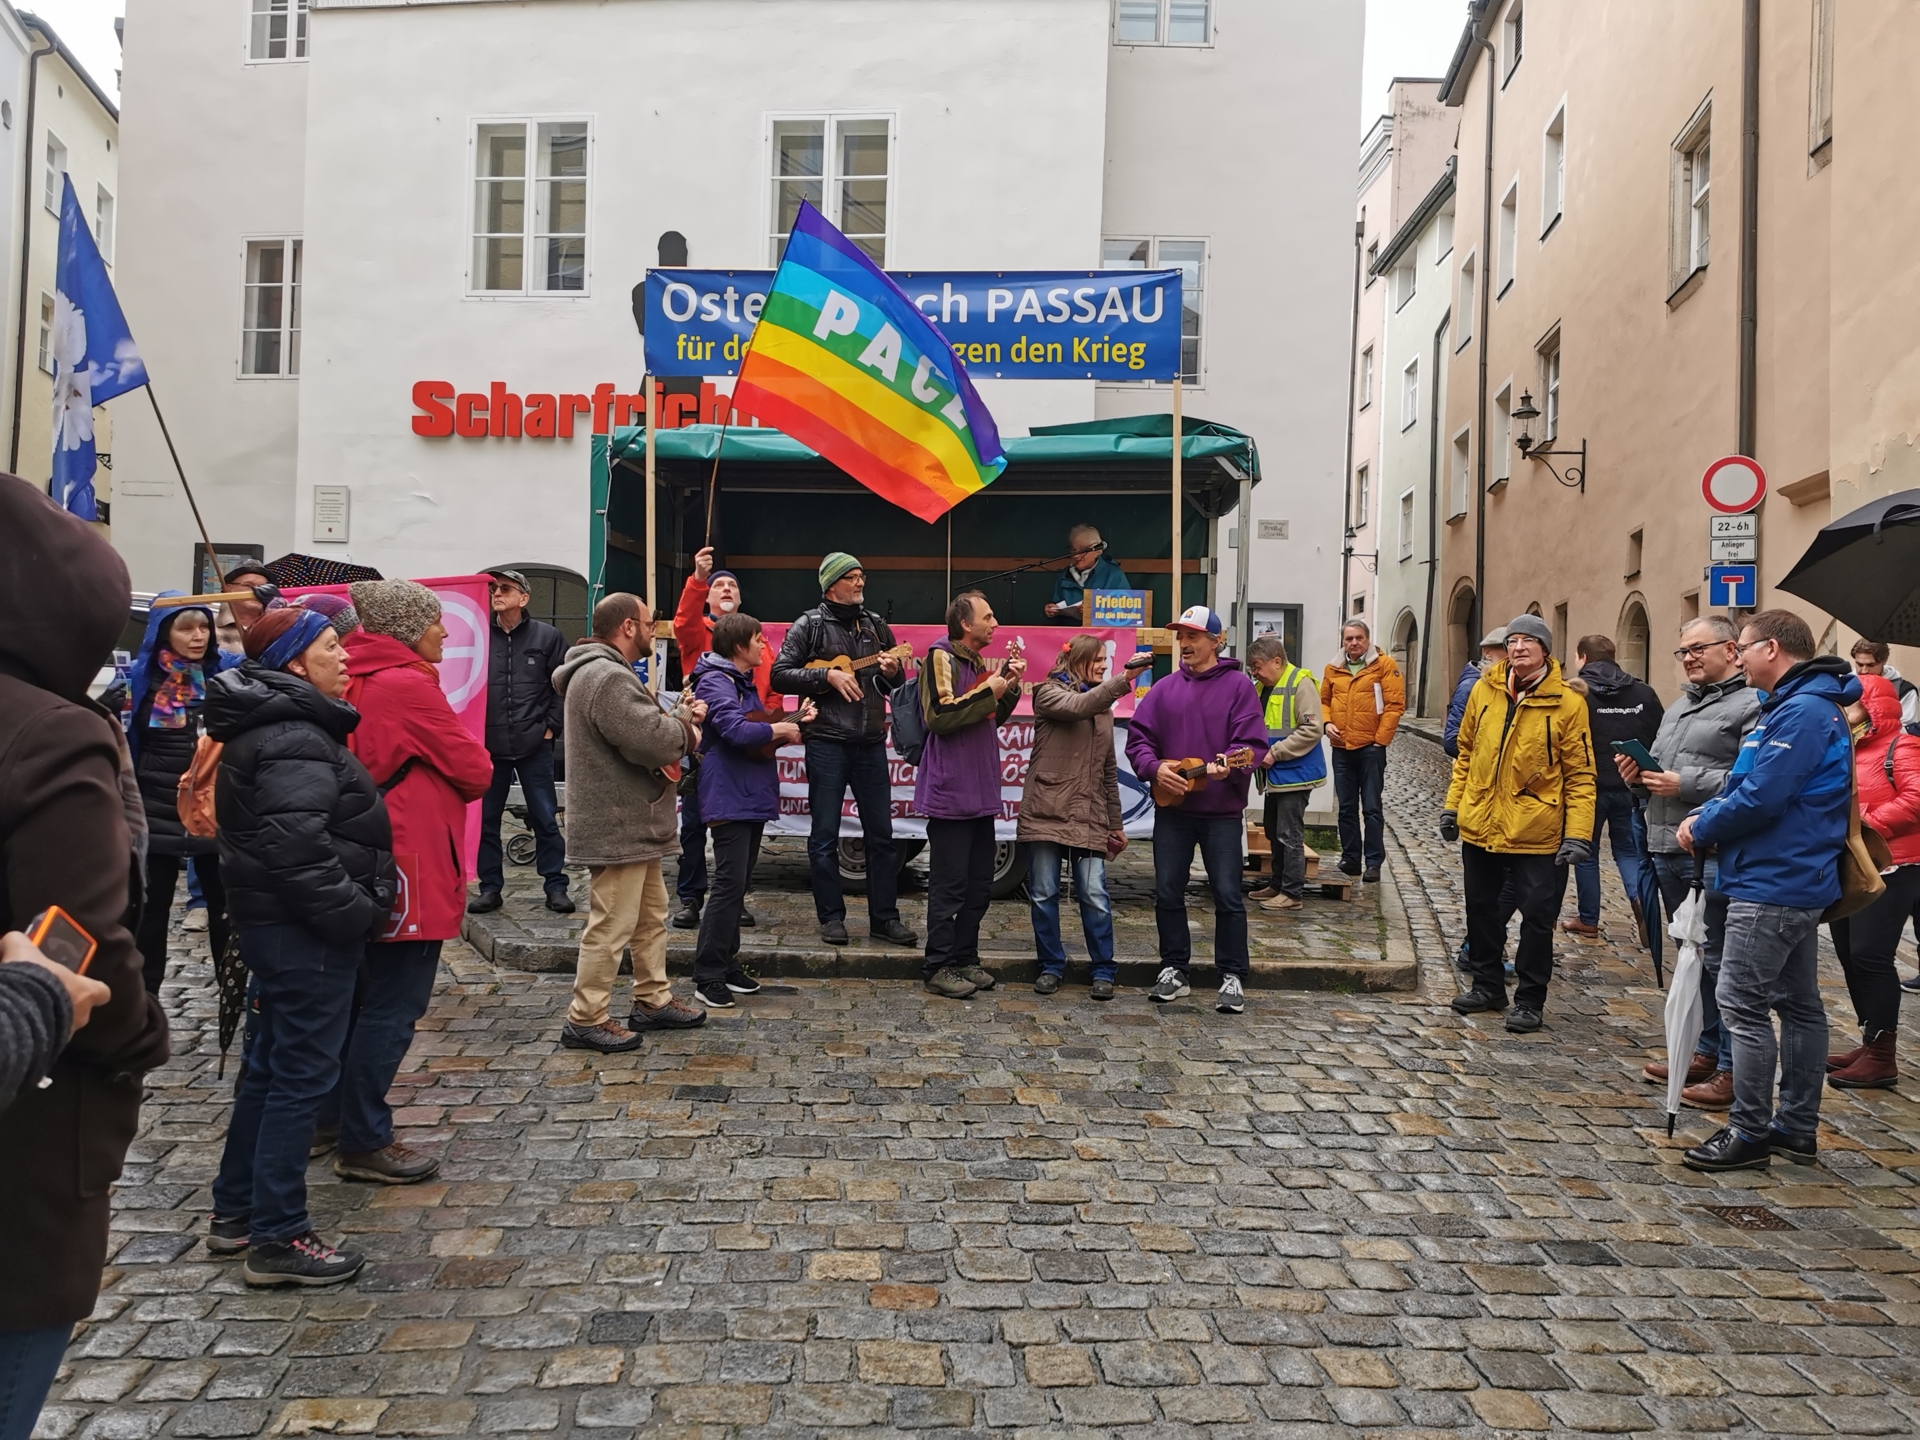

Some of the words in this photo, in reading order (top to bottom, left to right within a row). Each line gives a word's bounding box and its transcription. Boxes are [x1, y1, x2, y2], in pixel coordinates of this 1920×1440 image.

[988, 286, 1164, 324] PASSAU
[676, 333, 716, 361] für
[723, 333, 751, 361] de
[953, 343, 1001, 368] gen
[1009, 336, 1063, 362] den
[1073, 336, 1146, 369] Krieg
[412, 380, 776, 438] Scharfrich
[1721, 541, 1745, 549] Anlieger
[1095, 595, 1142, 609] Frieden
[1095, 611, 1105, 619] für
[1116, 612, 1141, 620] Ukraine
